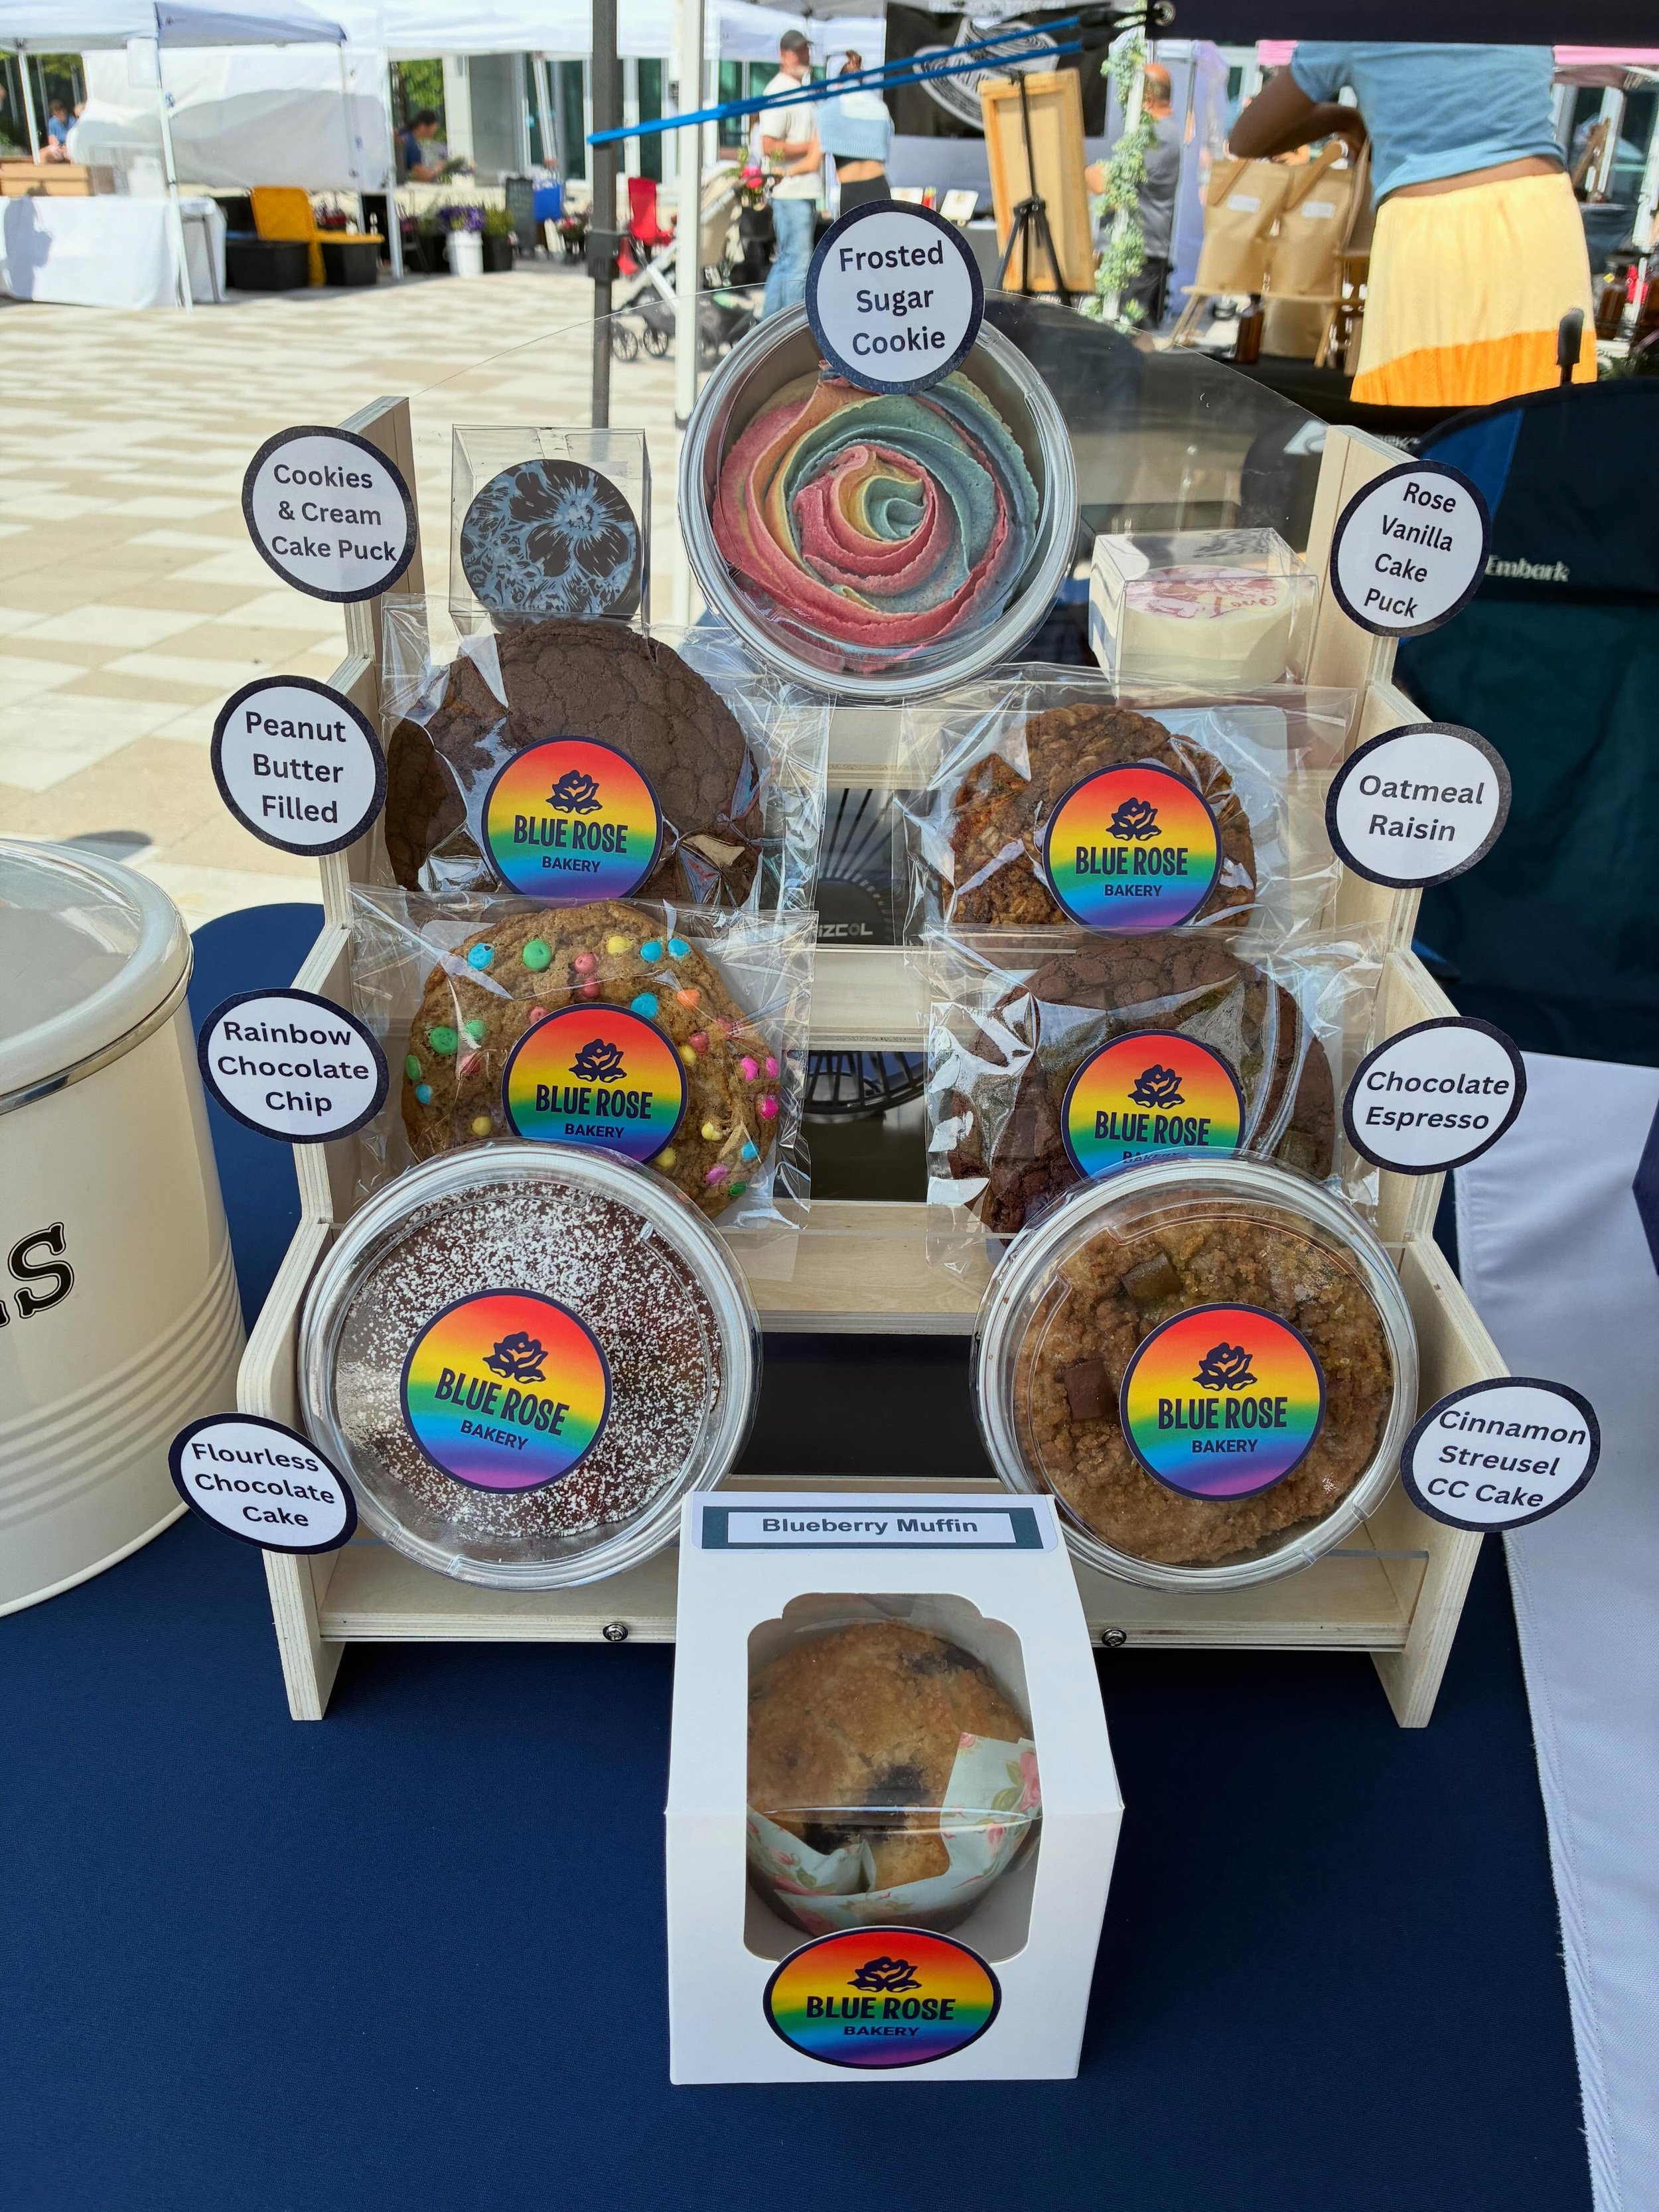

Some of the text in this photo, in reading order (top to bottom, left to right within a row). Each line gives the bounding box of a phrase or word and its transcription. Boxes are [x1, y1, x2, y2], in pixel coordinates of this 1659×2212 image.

[839, 240, 944, 272] Frosted
[856, 289, 934, 317] Sugar
[852, 325, 946, 356] Cookie
[273, 464, 373, 489] Cookies
[1402, 481, 1457, 513] Rose
[278, 500, 382, 526] & Cream
[1382, 514, 1453, 552] Vanilla
[271, 536, 397, 561] Cake Puck
[1374, 553, 1427, 583] Cake
[1484, 555, 1569, 582] Embark
[1364, 587, 1418, 619] Puck
[246, 711, 346, 743] Peanut
[253, 753, 344, 783] Butter
[1359, 775, 1484, 804] Oatmeal
[262, 794, 338, 824] Filled
[514, 814, 628, 853] BLUE ROSE
[1368, 814, 1455, 842] Raisin
[541, 855, 601, 873] BAKERY
[1075, 846, 1189, 877] BLUE ROSE
[1104, 884, 1163, 897] BAKERY
[223, 1021, 351, 1046] Rainbow
[218, 1055, 369, 1080] Chocolate
[1366, 1070, 1510, 1095] Chocolate
[265, 1090, 332, 1117] Chip
[536, 1084, 653, 1120] BLUE ROSE
[564, 1122, 625, 1139] BAKERY
[1094, 1110, 1211, 1146] BLUE ROSE
[1365, 1106, 1489, 1132] Espresso
[434, 1367, 570, 1436] BLUE ROSE
[1158, 1396, 1288, 1430] BLUE ROSE
[461, 1419, 529, 1451] BAKERY
[1439, 1410, 1586, 1445] Cinnamon
[191, 1443, 319, 1472] Flourless
[1192, 1439, 1258, 1453] BAKERY
[1438, 1445, 1560, 1476] Streusel
[194, 1473, 335, 1505] Chocolate
[1427, 1477, 1544, 1507] CC Cake
[242, 1506, 309, 1527] Cake
[762, 1517, 978, 1535] Blueberry Muffin
[806, 1996, 956, 2021] BLUE ROSE
[843, 2026, 920, 2037] BAKERY
